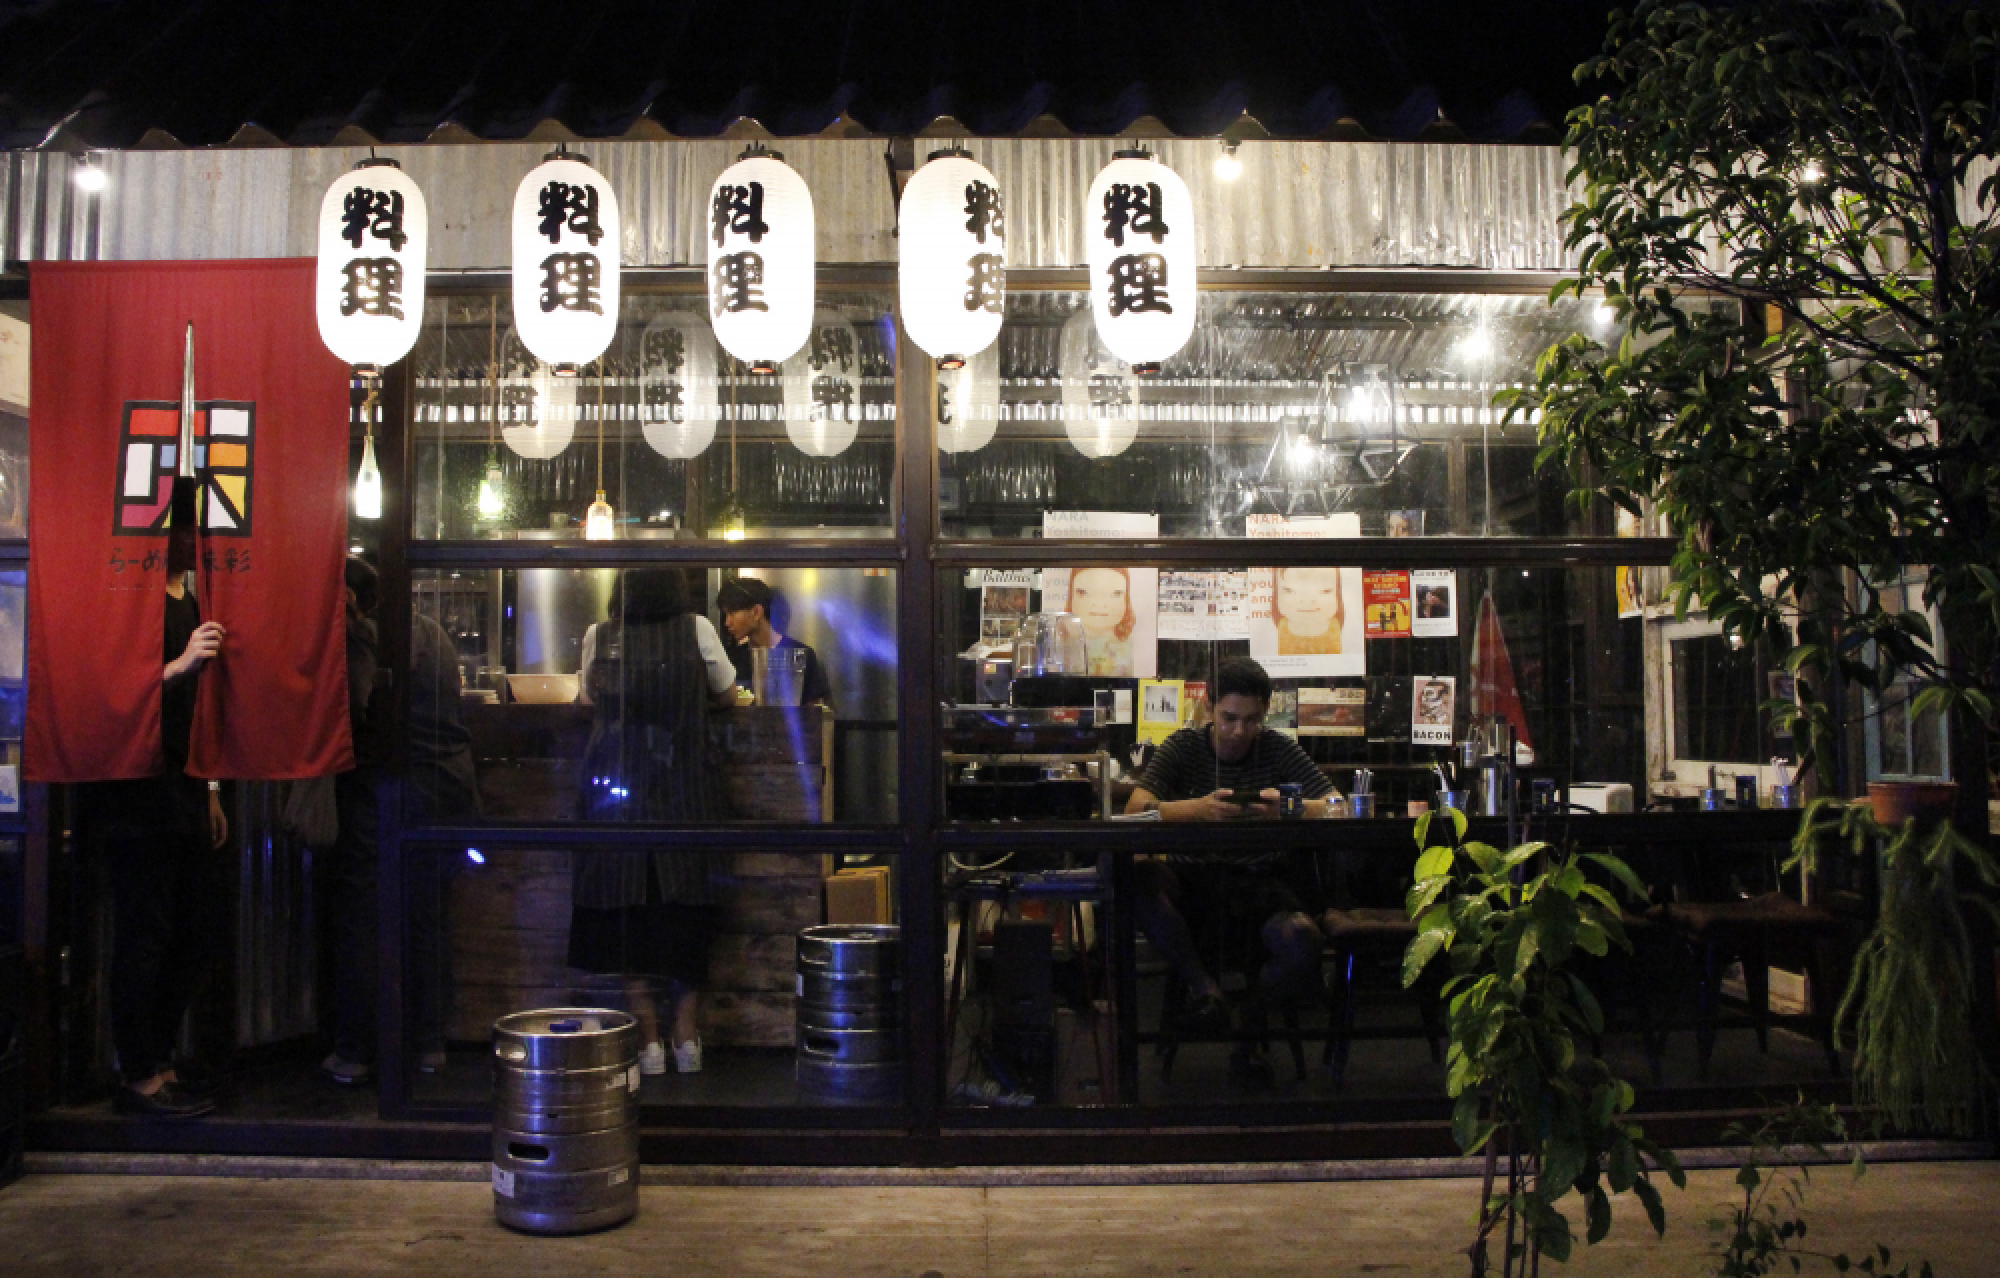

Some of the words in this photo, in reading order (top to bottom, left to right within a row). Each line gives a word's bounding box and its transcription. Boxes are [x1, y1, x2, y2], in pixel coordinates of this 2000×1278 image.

[341, 185, 408, 322] 料理
[537, 181, 603, 318] 料理
[711, 181, 769, 317] 料理
[1103, 181, 1173, 318] 料理
[1413, 730, 1451, 741] BACON
